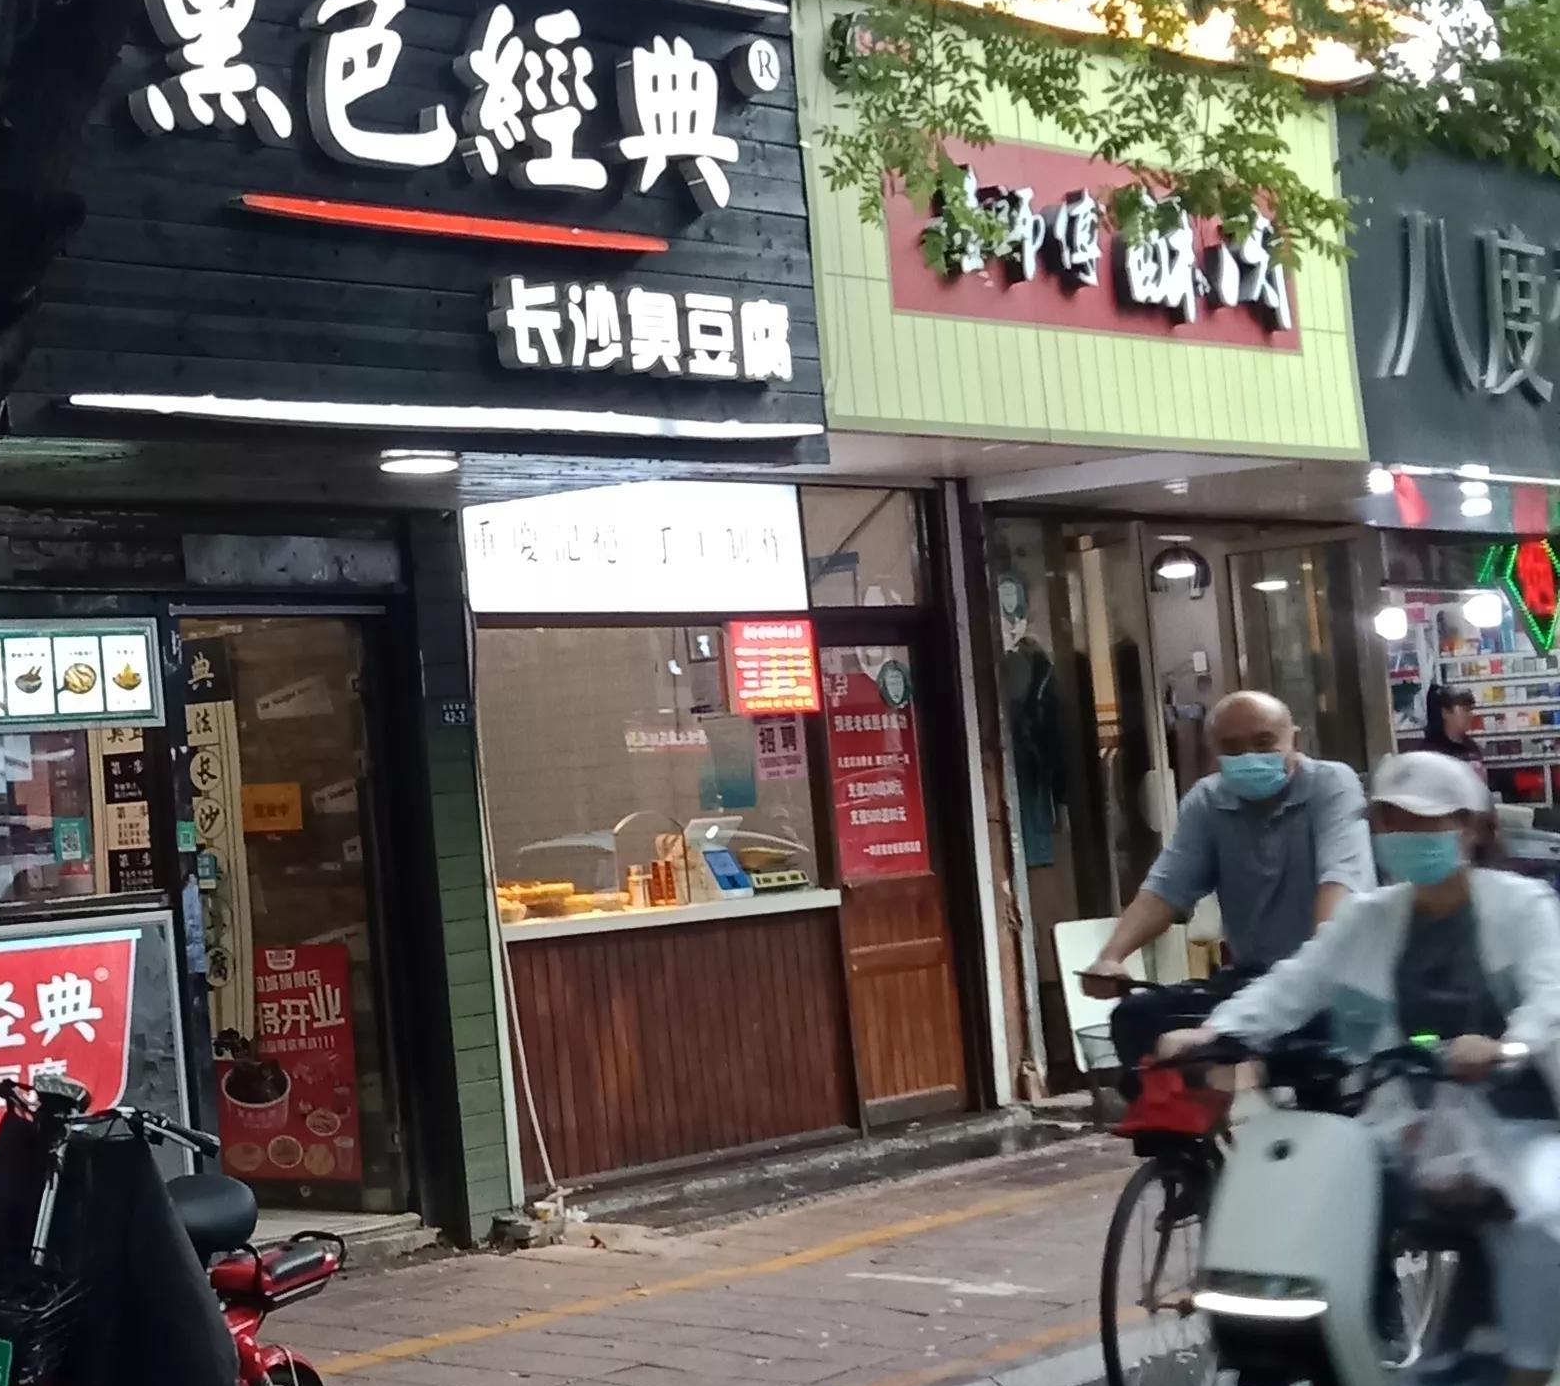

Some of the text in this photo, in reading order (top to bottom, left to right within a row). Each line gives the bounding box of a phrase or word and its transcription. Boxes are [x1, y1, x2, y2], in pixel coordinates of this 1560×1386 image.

[492, 275, 793, 383] 长沙臭豆腐
[1377, 210, 1560, 404] 八度
